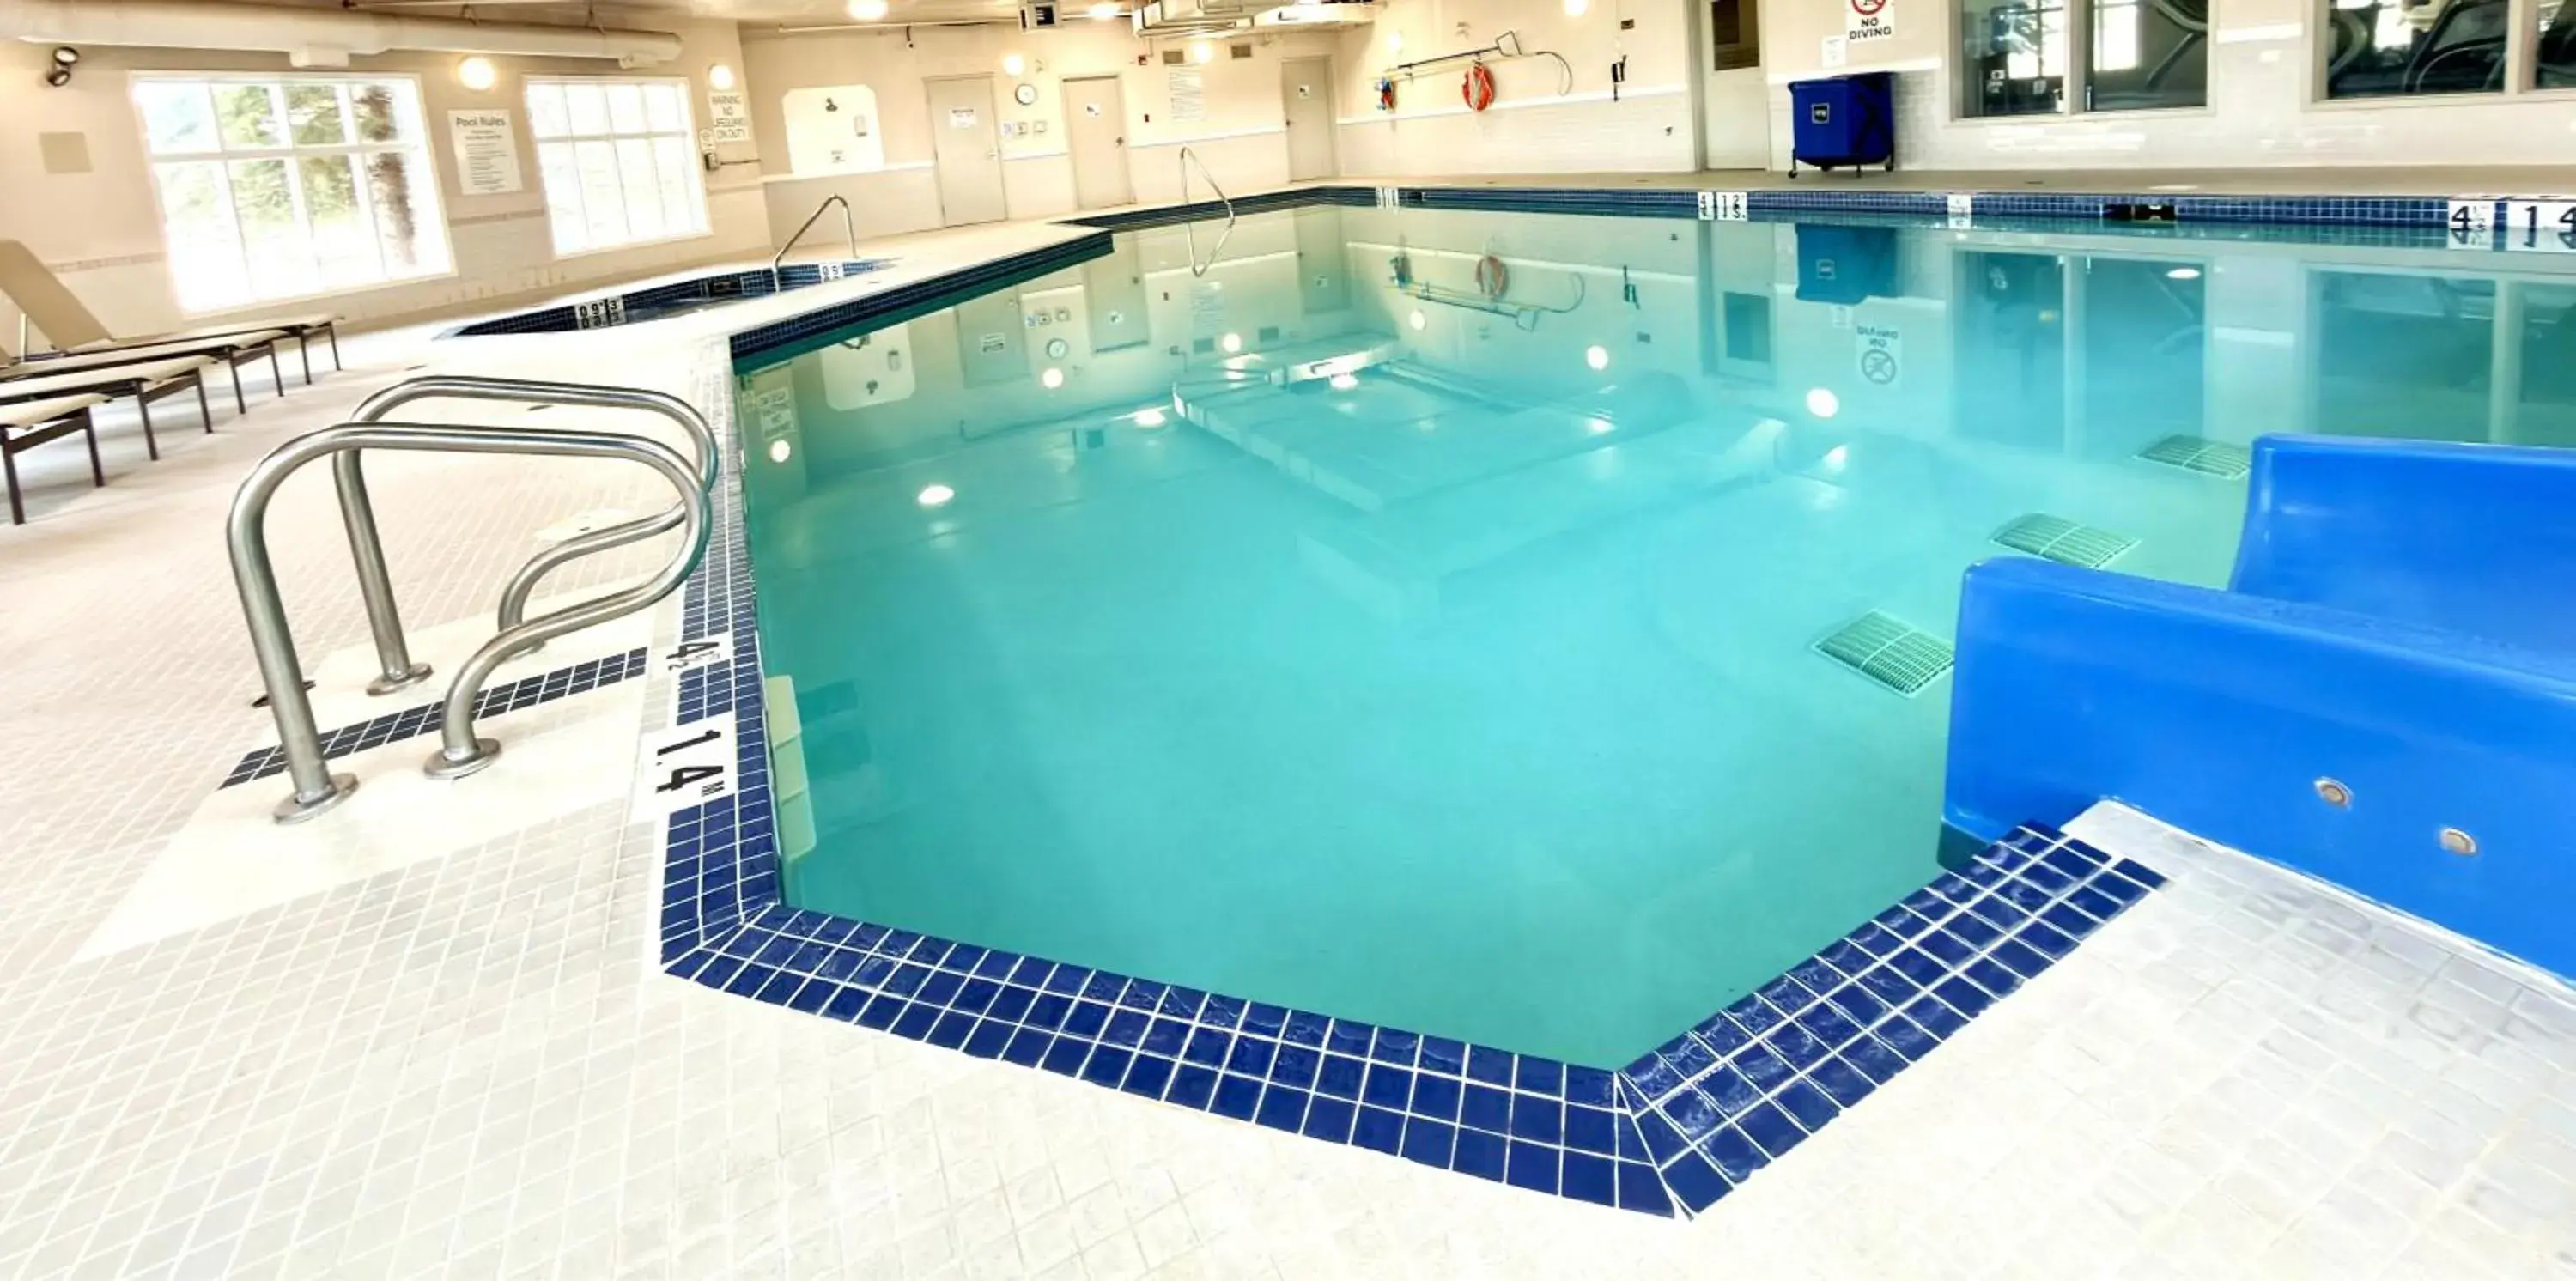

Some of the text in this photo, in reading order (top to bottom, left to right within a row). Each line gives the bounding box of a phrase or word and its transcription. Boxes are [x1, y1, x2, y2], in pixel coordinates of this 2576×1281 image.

[1861, 17, 1879, 27] NO
[1849, 26, 1892, 40] DIVING
[456, 115, 506, 128] Pool Rules
